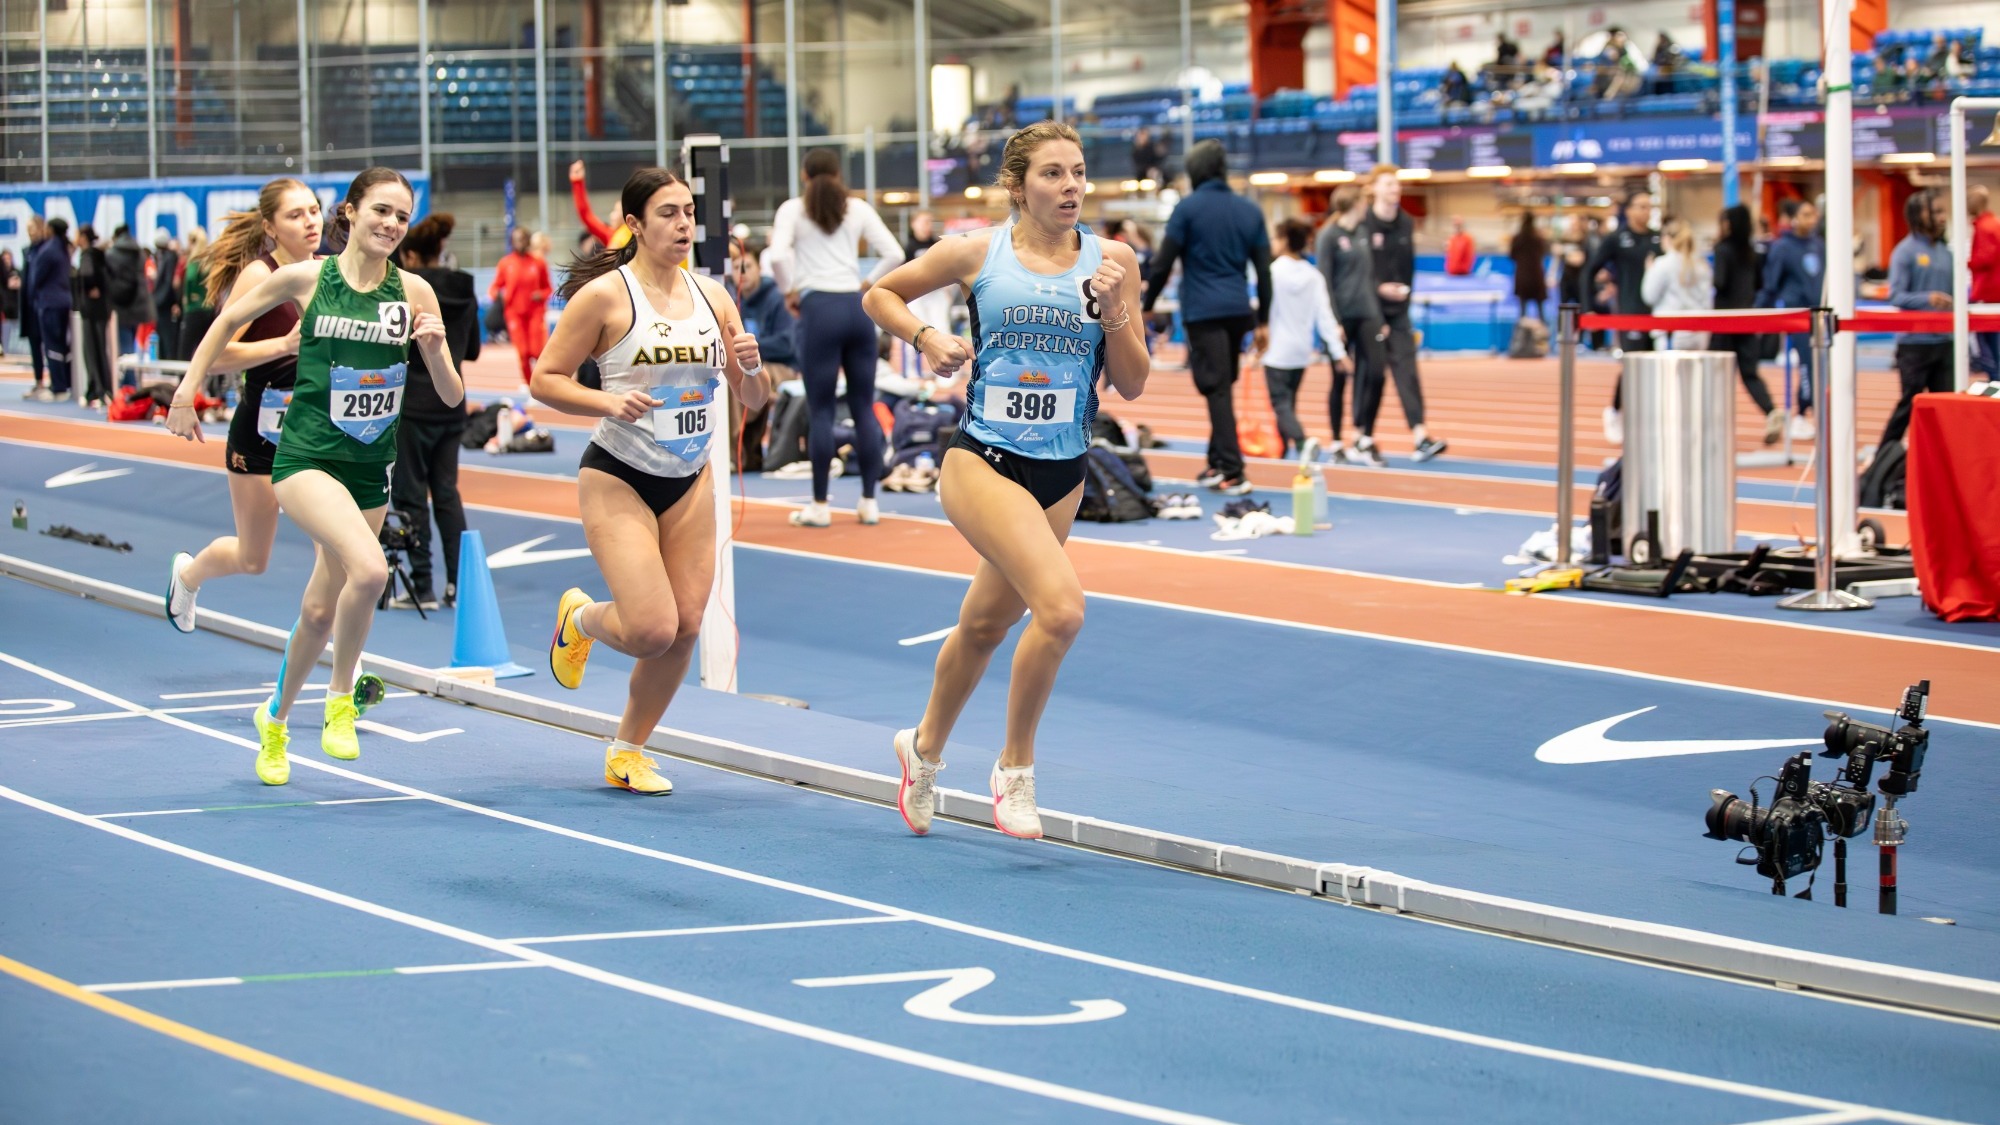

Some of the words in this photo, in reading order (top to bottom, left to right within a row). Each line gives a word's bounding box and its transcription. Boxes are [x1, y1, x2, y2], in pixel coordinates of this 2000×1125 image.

[1082, 278, 1102, 320] 8
[313, 315, 404, 346] WAGN
[384, 304, 407, 338] 9
[1002, 305, 1084, 333] JOHNS
[711, 338, 727, 367] 16
[986, 331, 1091, 356] HOPKINS
[343, 391, 396, 417] 2924
[1006, 391, 1057, 420] 398
[674, 408, 707, 435] 105
